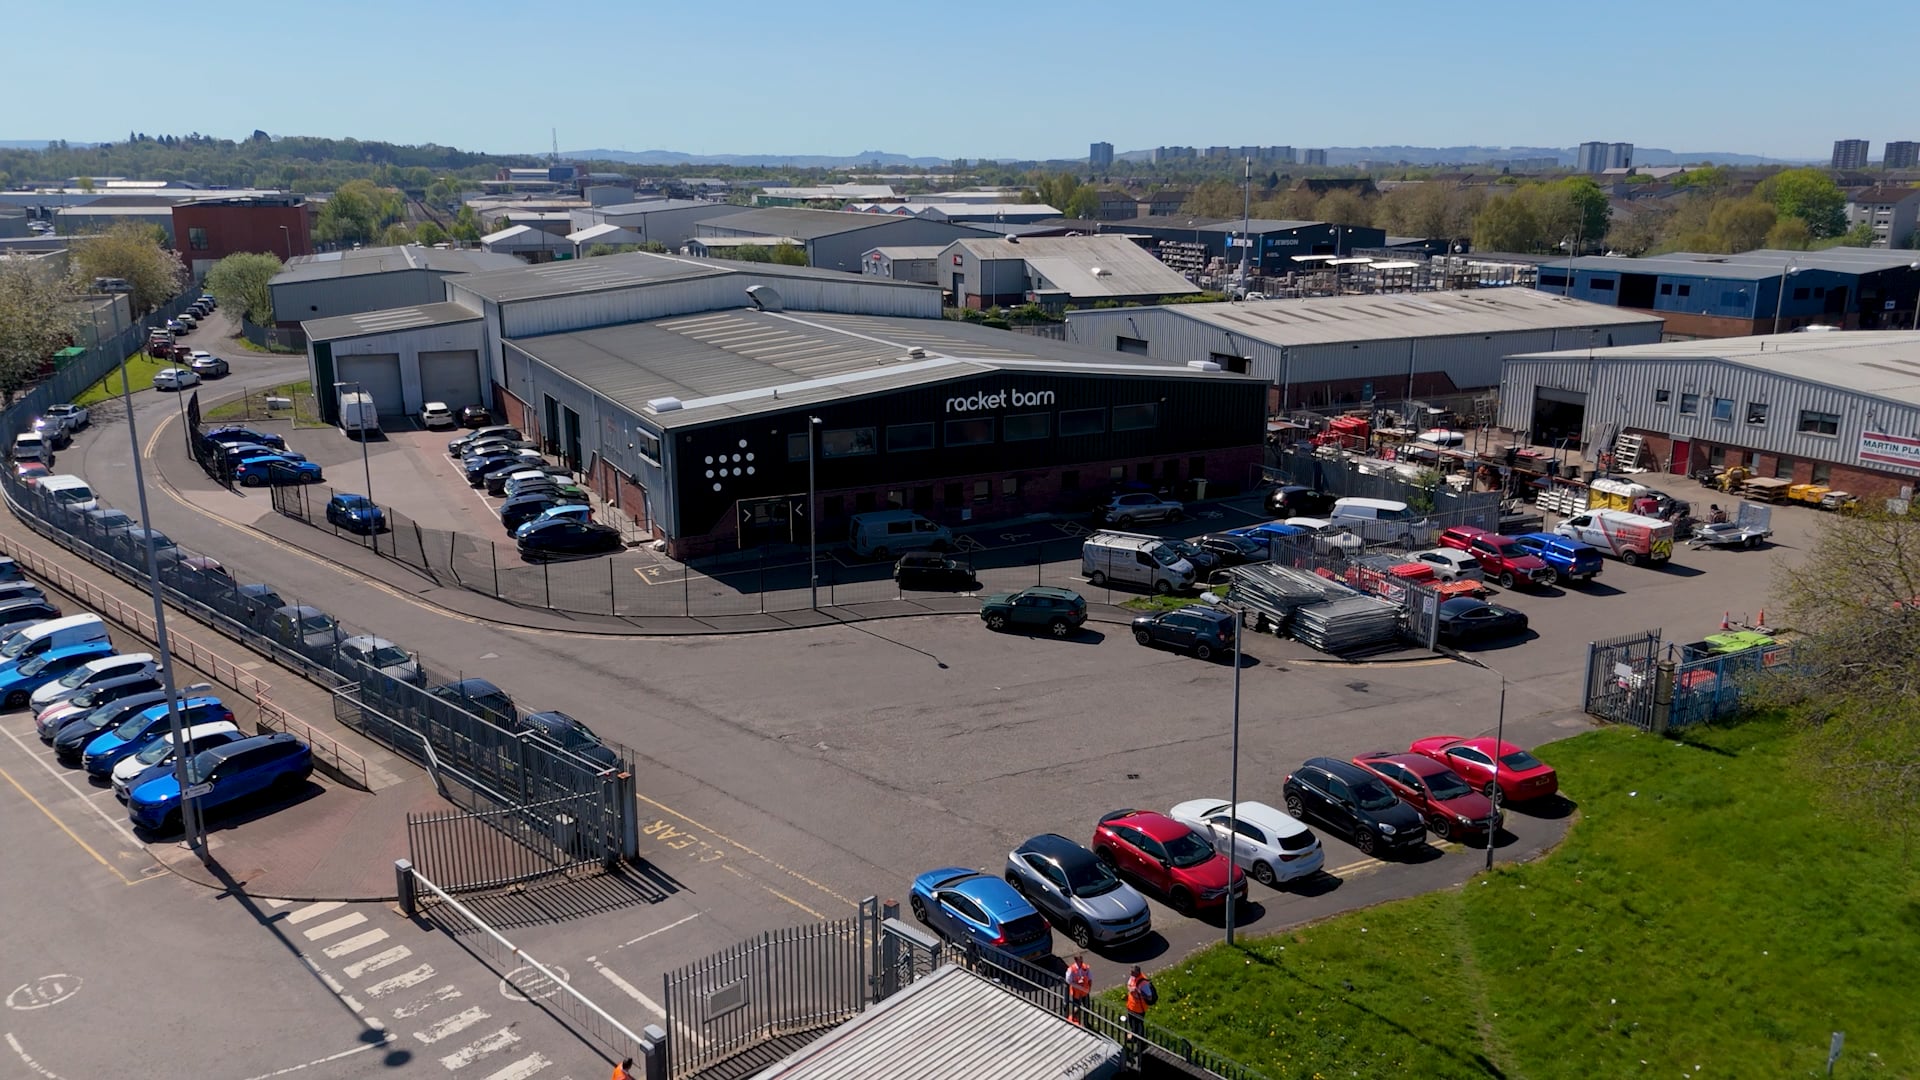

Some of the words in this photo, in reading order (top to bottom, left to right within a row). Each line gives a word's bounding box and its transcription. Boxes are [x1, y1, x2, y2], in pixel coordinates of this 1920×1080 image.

[946, 389, 1007, 412] racket
[1012, 388, 1055, 407] barn
[1863, 440, 1899, 452] MARTIN
